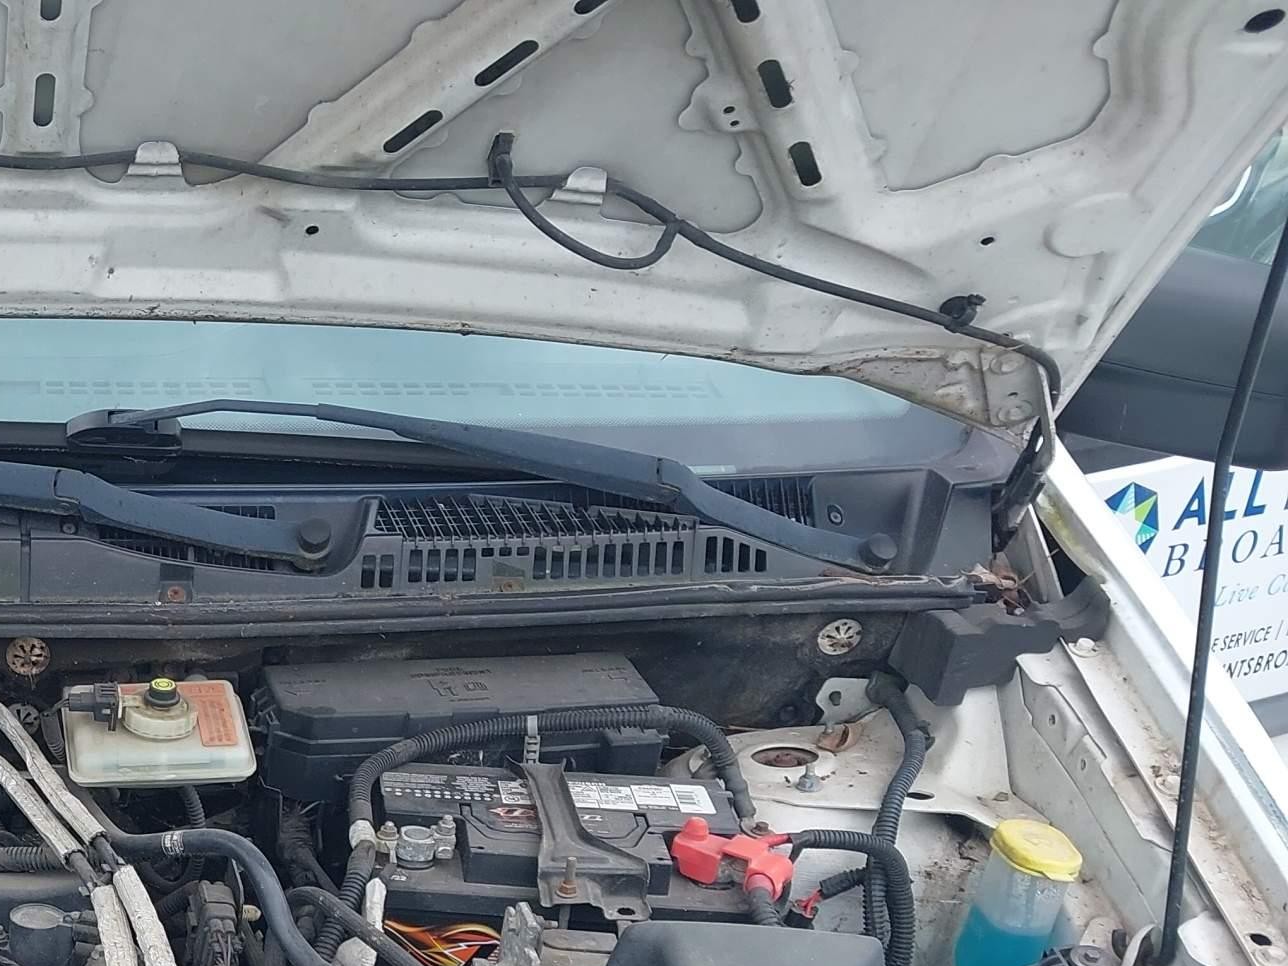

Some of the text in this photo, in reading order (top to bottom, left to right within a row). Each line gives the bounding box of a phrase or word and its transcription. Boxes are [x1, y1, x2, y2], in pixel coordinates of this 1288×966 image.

[1161, 524, 1288, 578] BOA
[1220, 625, 1272, 651] SERVICE
[1222, 649, 1288, 679] NTSBRO
